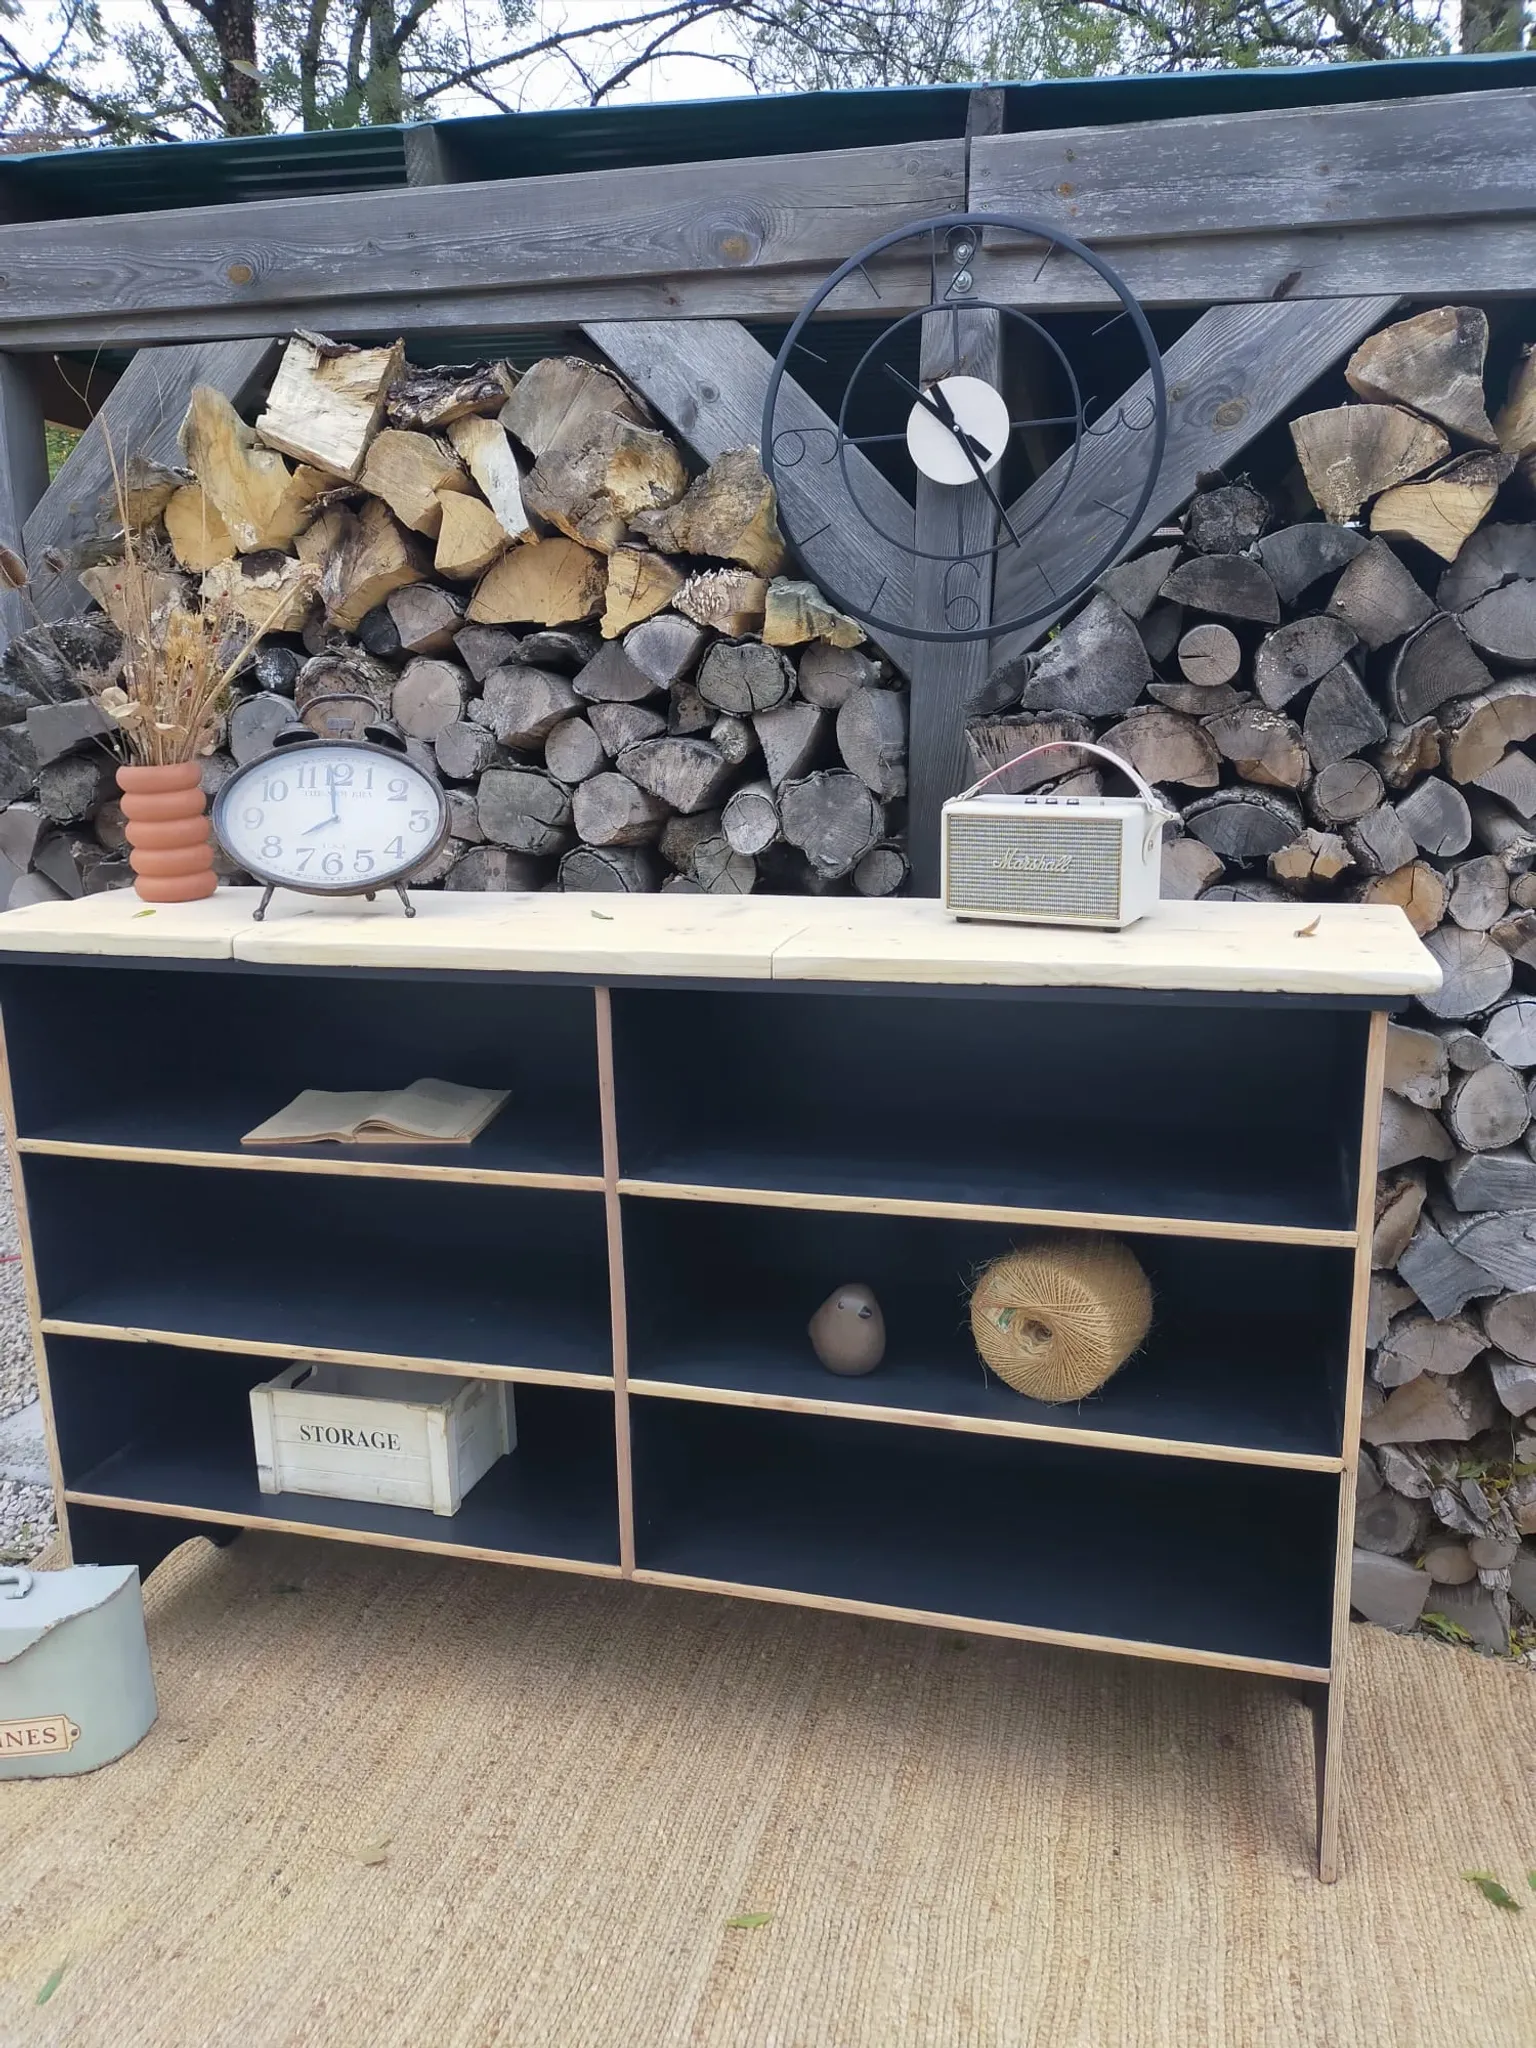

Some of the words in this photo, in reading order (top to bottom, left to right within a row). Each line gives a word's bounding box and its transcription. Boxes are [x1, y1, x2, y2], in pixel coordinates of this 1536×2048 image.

[944, 561, 981, 631] 6
[297, 765, 317, 789] 11
[325, 763, 354, 787] 12
[365, 767, 373, 790] 1
[262, 779, 289, 803] 10
[387, 779, 409, 802] 2
[243, 807, 264, 830] 9
[408, 810, 431, 833] 3
[261, 835, 283, 859] 8
[383, 835, 406, 860] 4
[295, 848, 315, 872] 7
[321, 852, 343, 875] 6
[353, 850, 375, 873] 5
[992, 848, 1074, 873] Marshall
[300, 1424, 400, 1451] STORAGE
[0, 1727, 57, 1748] NES
